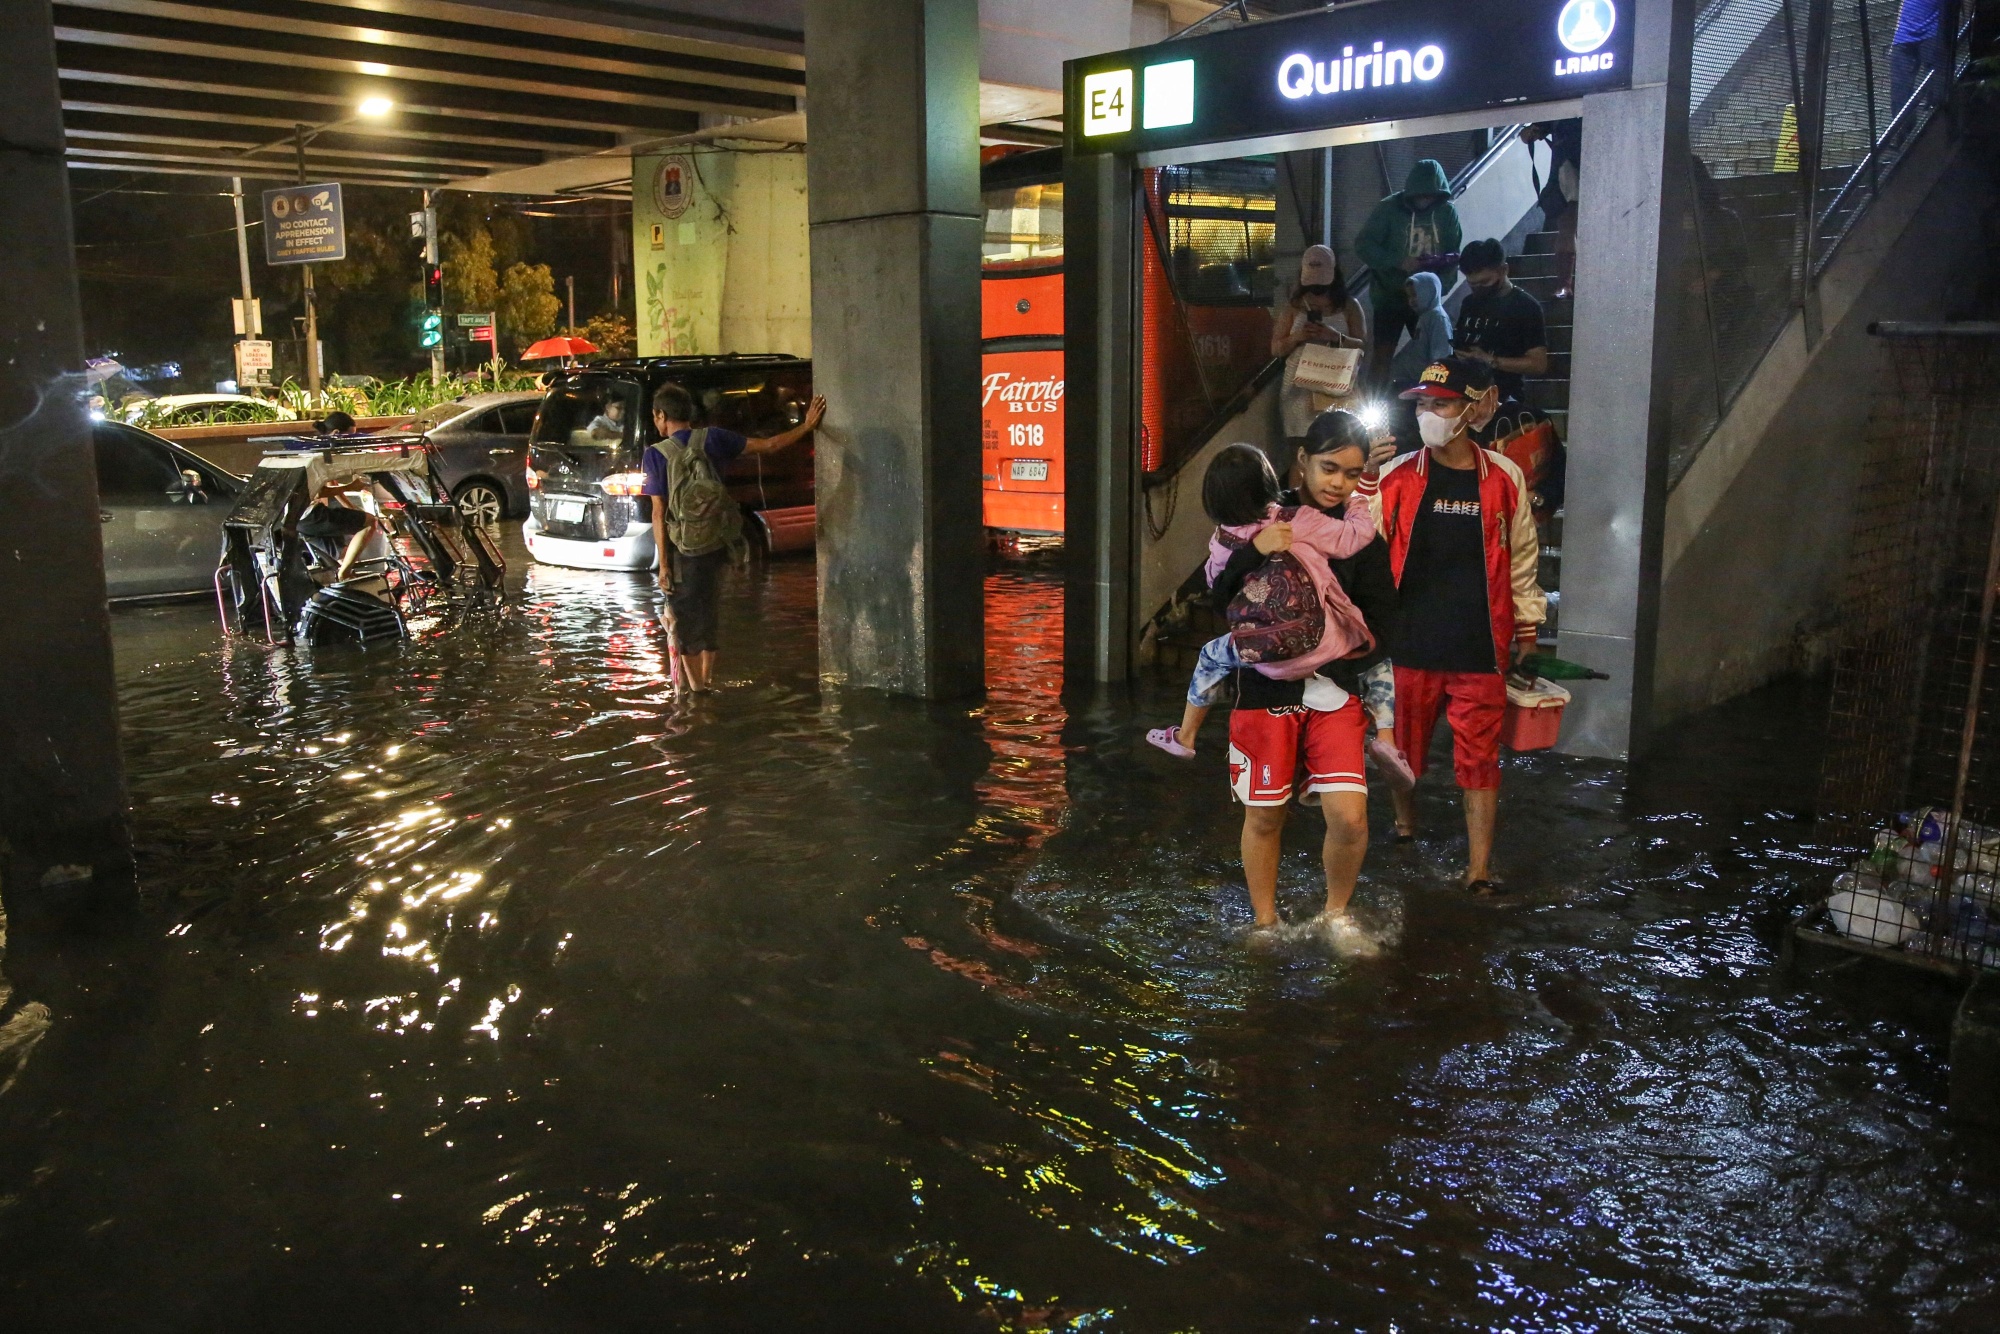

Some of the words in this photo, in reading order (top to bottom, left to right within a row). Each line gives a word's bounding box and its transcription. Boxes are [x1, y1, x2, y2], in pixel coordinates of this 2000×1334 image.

[1278, 41, 1444, 99] Quirino
[1555, 52, 1613, 76] LRMC
[1091, 86, 1125, 120] E4
[280, 221, 292, 230] NO
[293, 218, 329, 228] CONTACT
[275, 226, 335, 240] APPREHENSION
[286, 239, 294, 248] IN
[295, 236, 324, 247] EFFECT
[292, 247, 316, 255] TRAFFIC
[1301, 359, 1352, 371] PENSHOPPE
[982, 372, 1065, 408] Fairvie
[1008, 401, 1057, 413] BUS
[1007, 423, 1044, 447] 1618
[1012, 466, 1026, 477] NAP
